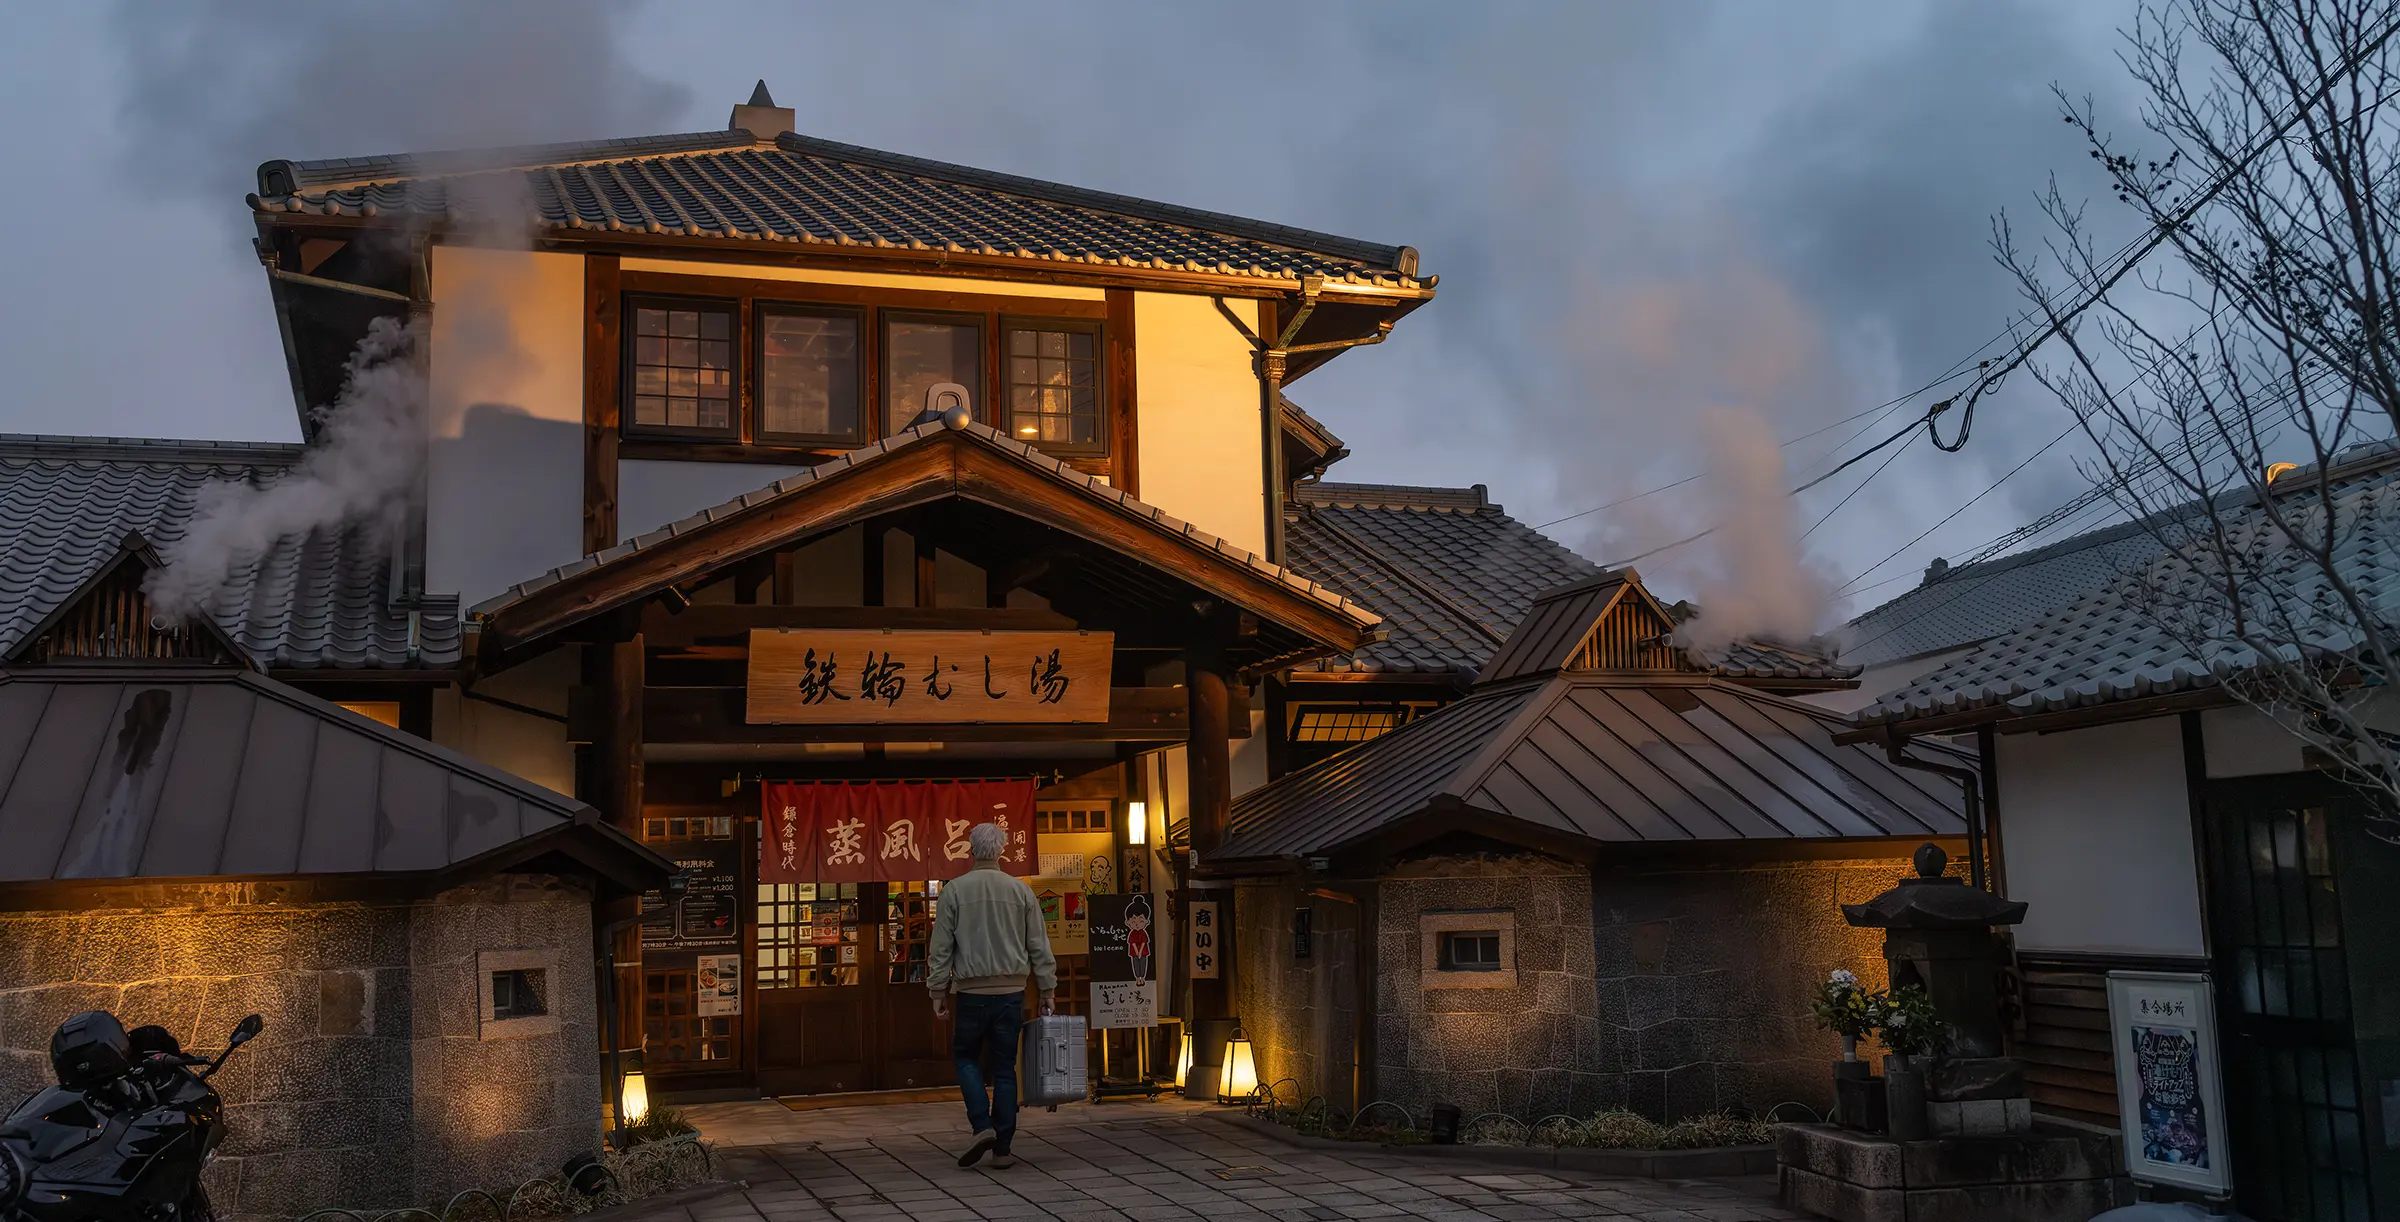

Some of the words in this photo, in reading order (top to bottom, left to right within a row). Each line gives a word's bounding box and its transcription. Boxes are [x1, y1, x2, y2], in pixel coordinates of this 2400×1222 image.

[798, 647, 1070, 709] 鉄輪むし湯
[781, 805, 798, 871] 鎌倉時代
[826, 816, 972, 866] 蒸風呂
[1013, 829, 1027, 863] 開基
[1195, 908, 1212, 971] 商い中
[2140, 999, 2185, 1017] 集合場所
